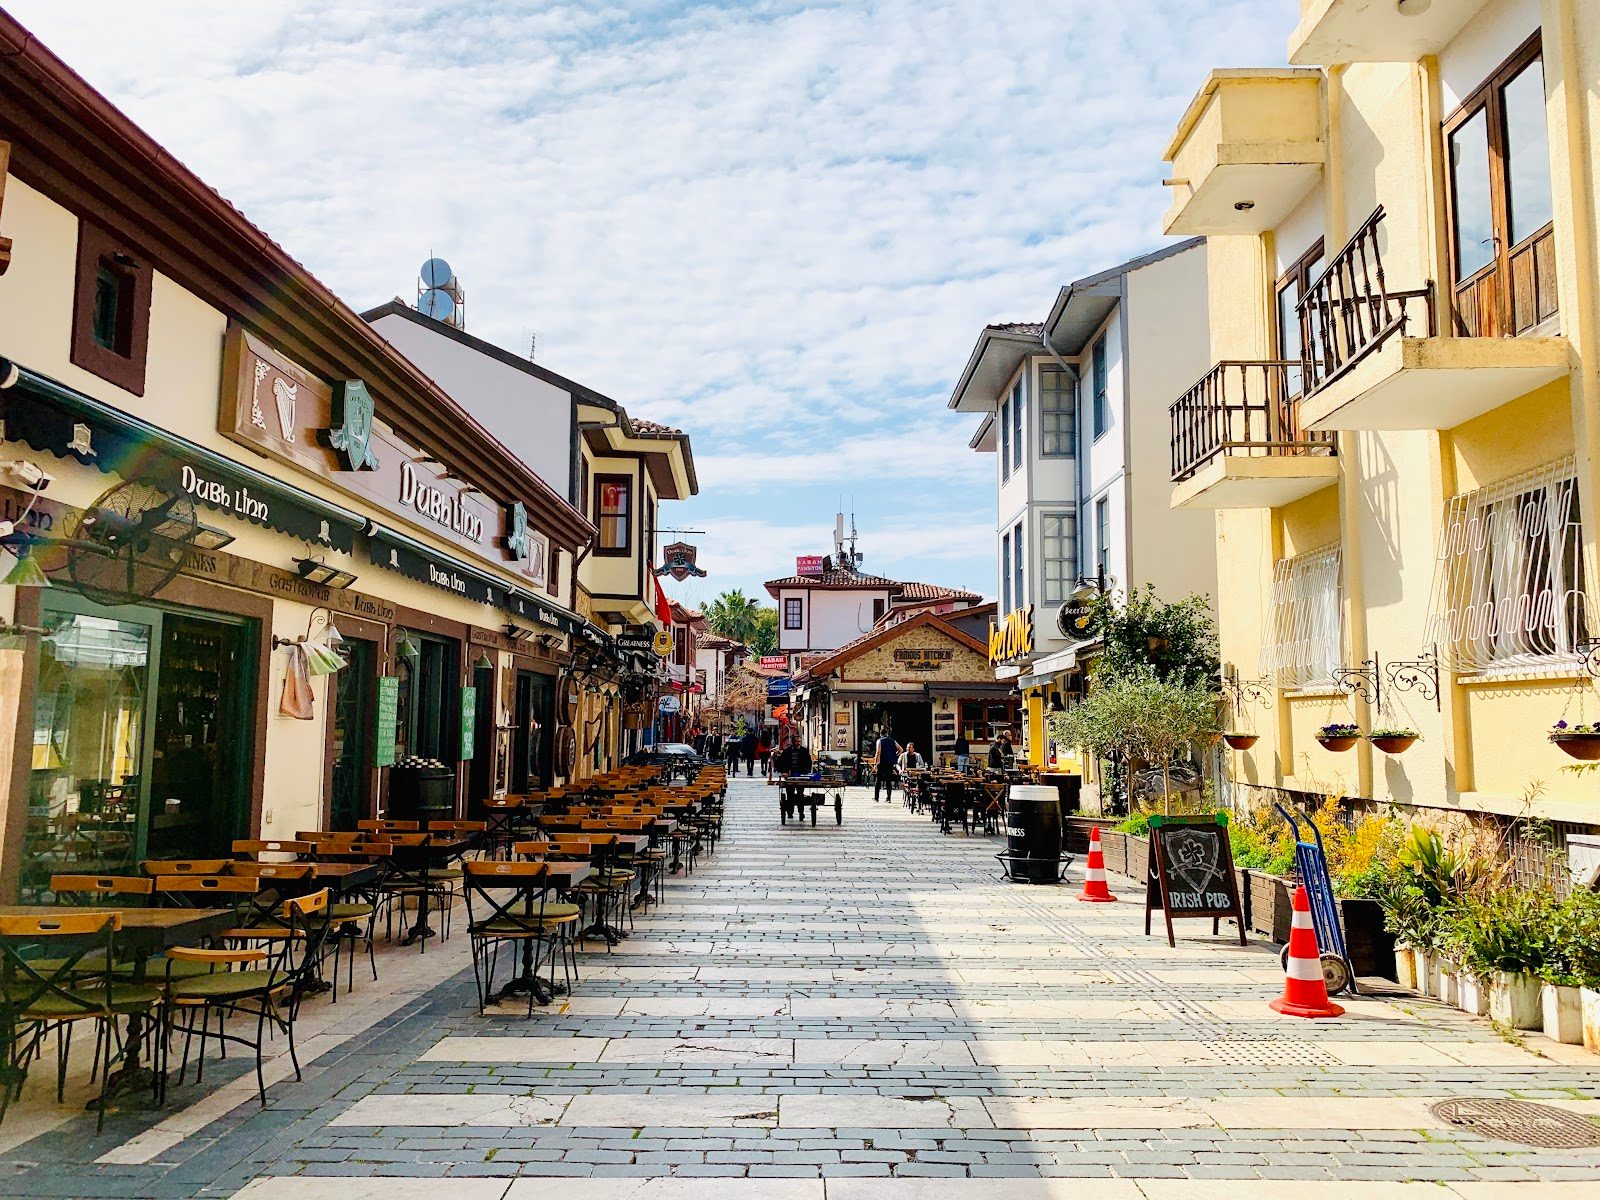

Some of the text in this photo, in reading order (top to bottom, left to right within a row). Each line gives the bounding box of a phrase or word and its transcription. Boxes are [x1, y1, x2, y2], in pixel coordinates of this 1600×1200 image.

[617, 638, 651, 649] GREATNESS
[924, 650, 953, 660] KITCHEN
[1169, 891, 1231, 908] IRISH PUB
